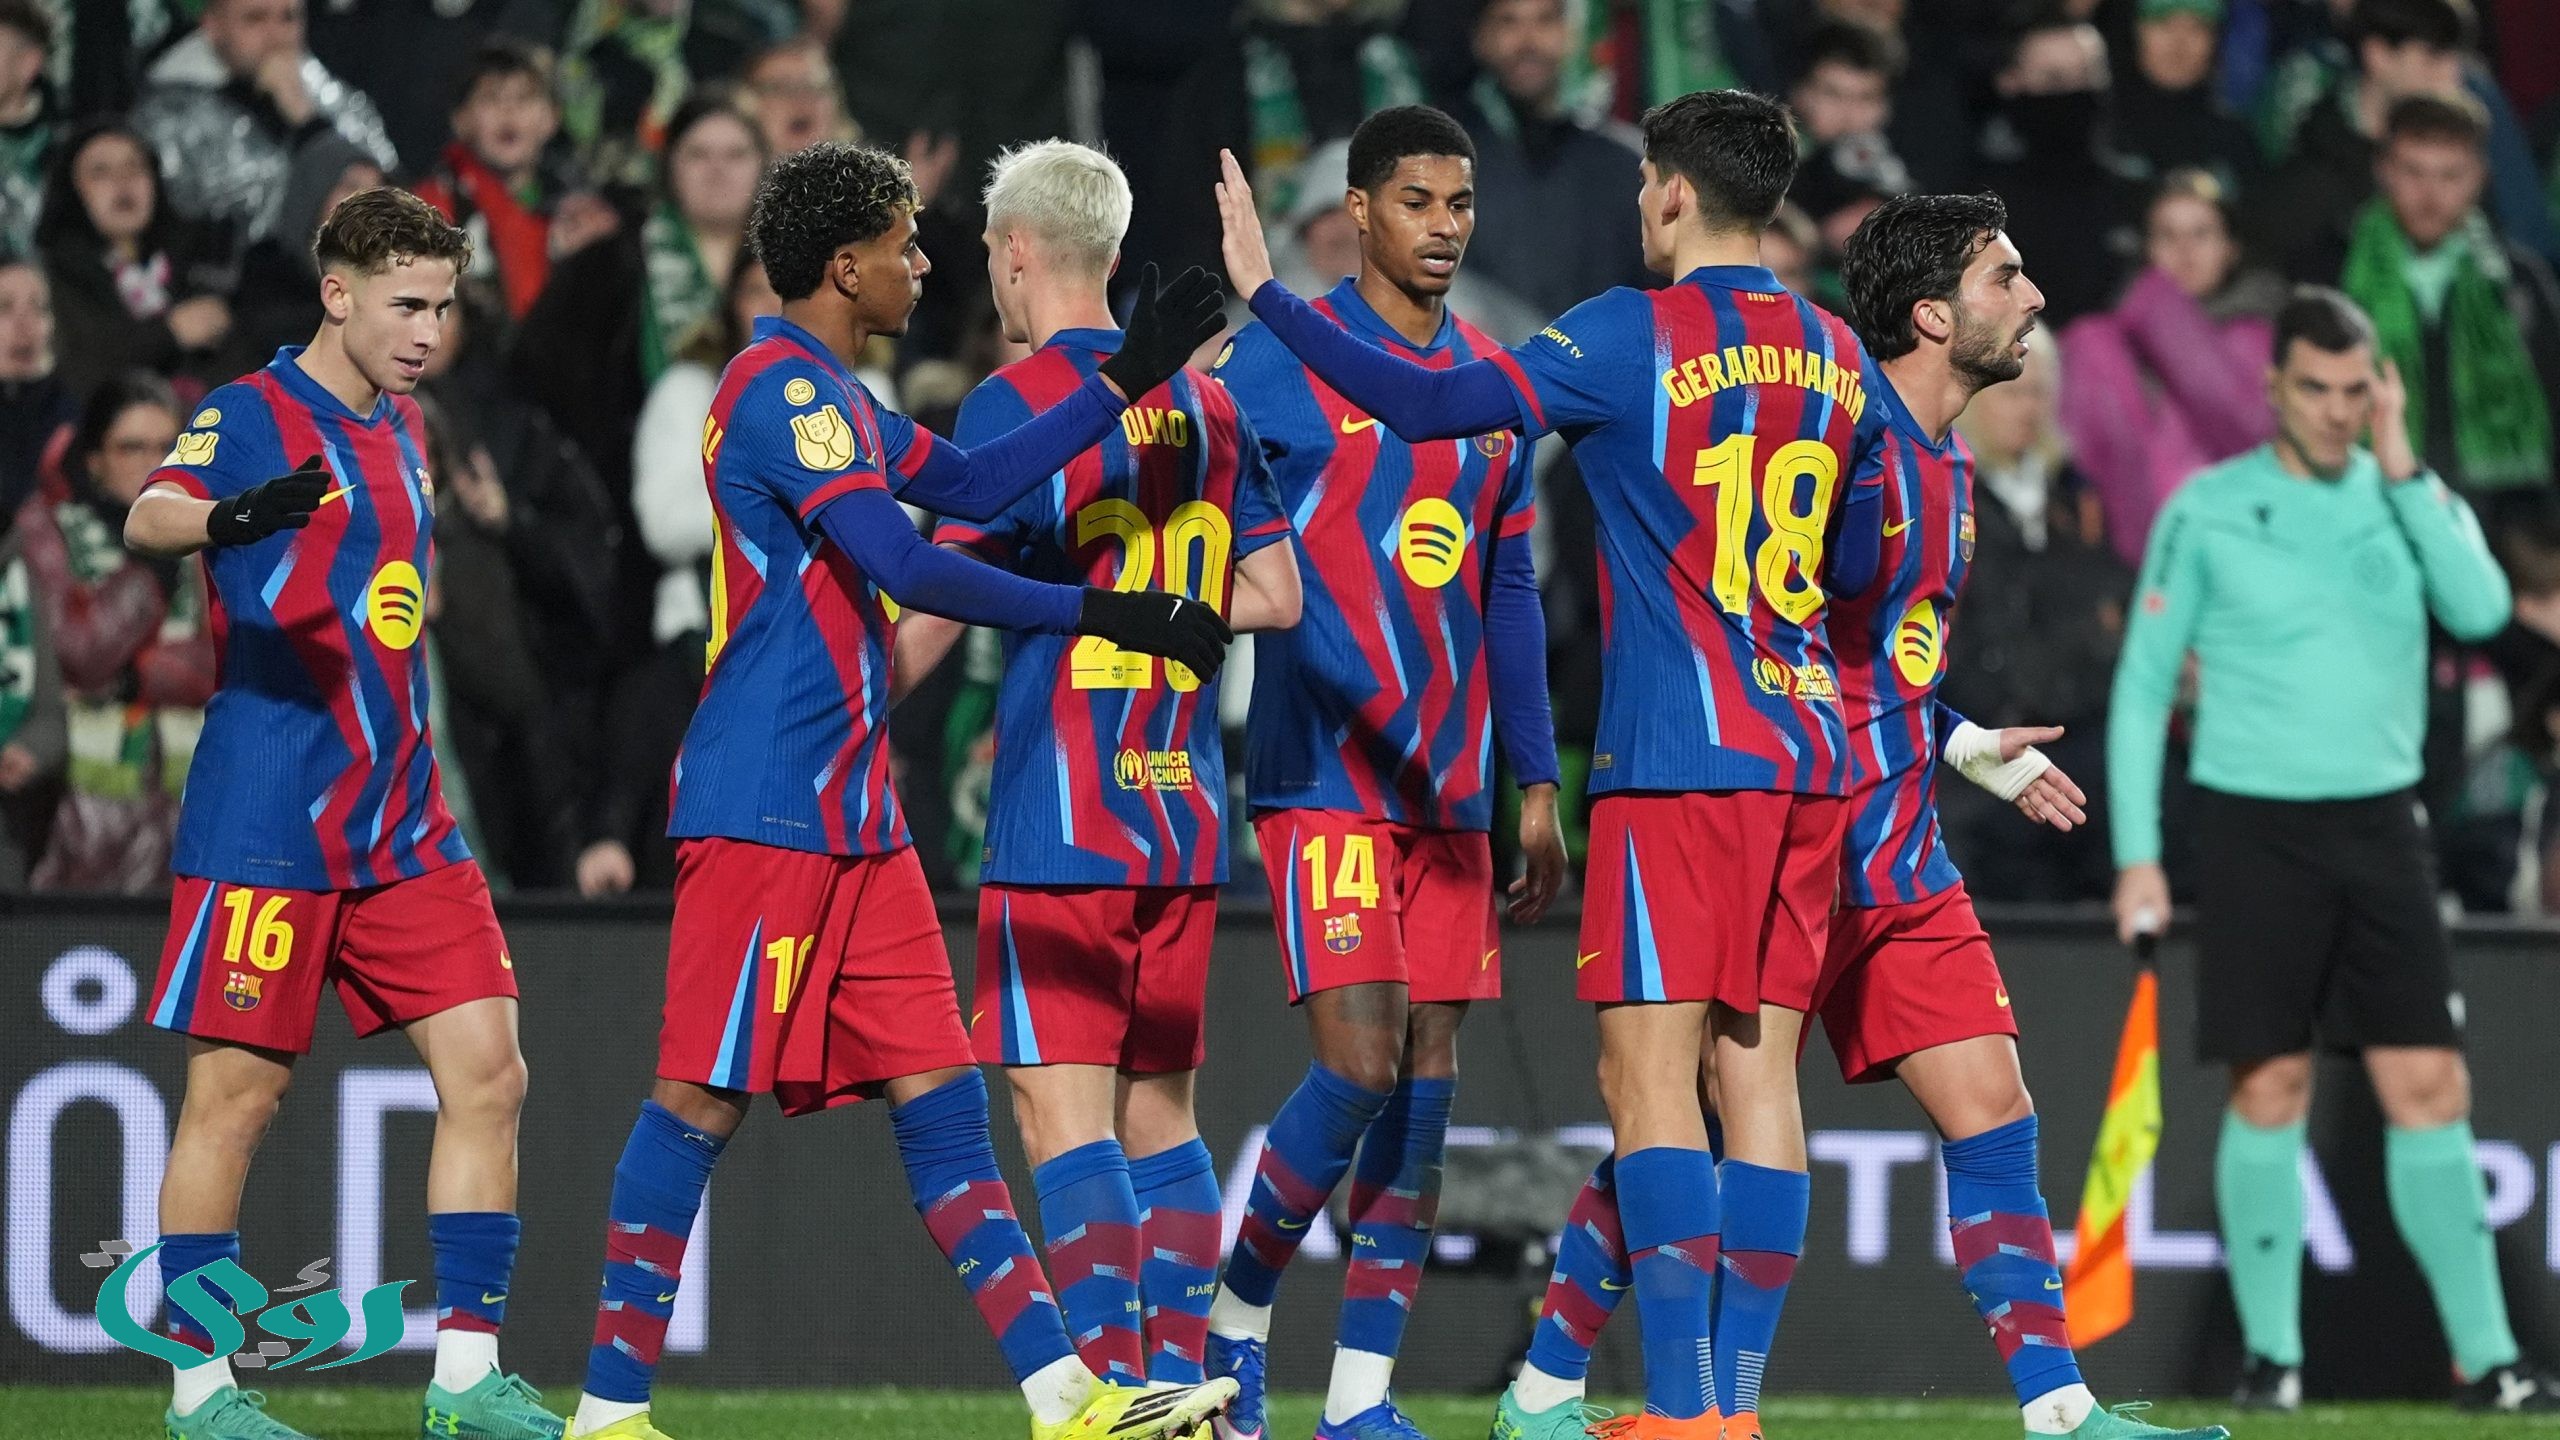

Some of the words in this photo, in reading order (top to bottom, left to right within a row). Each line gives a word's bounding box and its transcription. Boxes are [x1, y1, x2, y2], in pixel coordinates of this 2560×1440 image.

[791, 386, 808, 397] 32
[1661, 345, 1781, 408] GERARD
[1784, 346, 1867, 425] MARTÍN
[1120, 406, 1189, 448] OLMO
[1693, 433, 1839, 625] 18
[1071, 498, 1231, 692] 20
[1147, 751, 1190, 767] UNHCR
[1149, 767, 1193, 784] ACNUR
[1303, 833, 1380, 911] 14
[223, 887, 294, 971] 16
